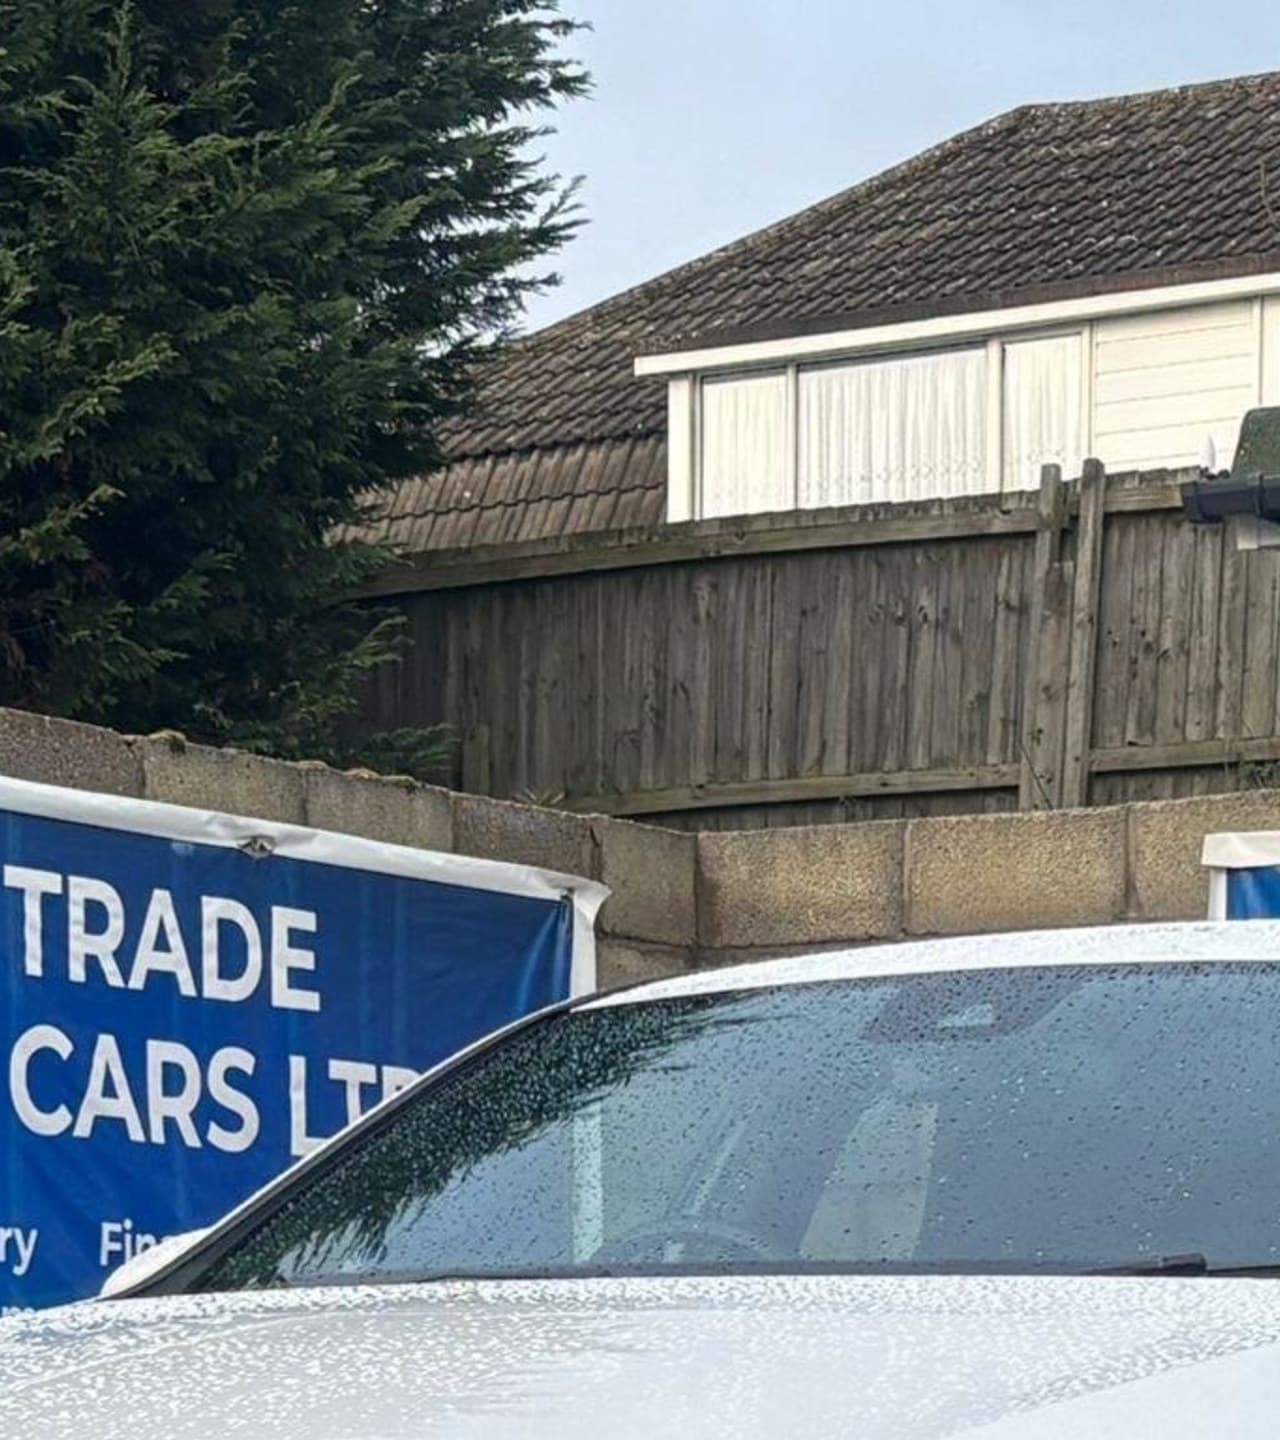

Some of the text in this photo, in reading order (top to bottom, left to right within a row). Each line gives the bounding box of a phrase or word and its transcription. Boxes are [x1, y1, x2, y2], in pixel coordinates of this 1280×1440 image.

[3, 864, 321, 1013] TRADE
[9, 1024, 261, 1154] CARS
[99, 1218, 170, 1267] Fin
